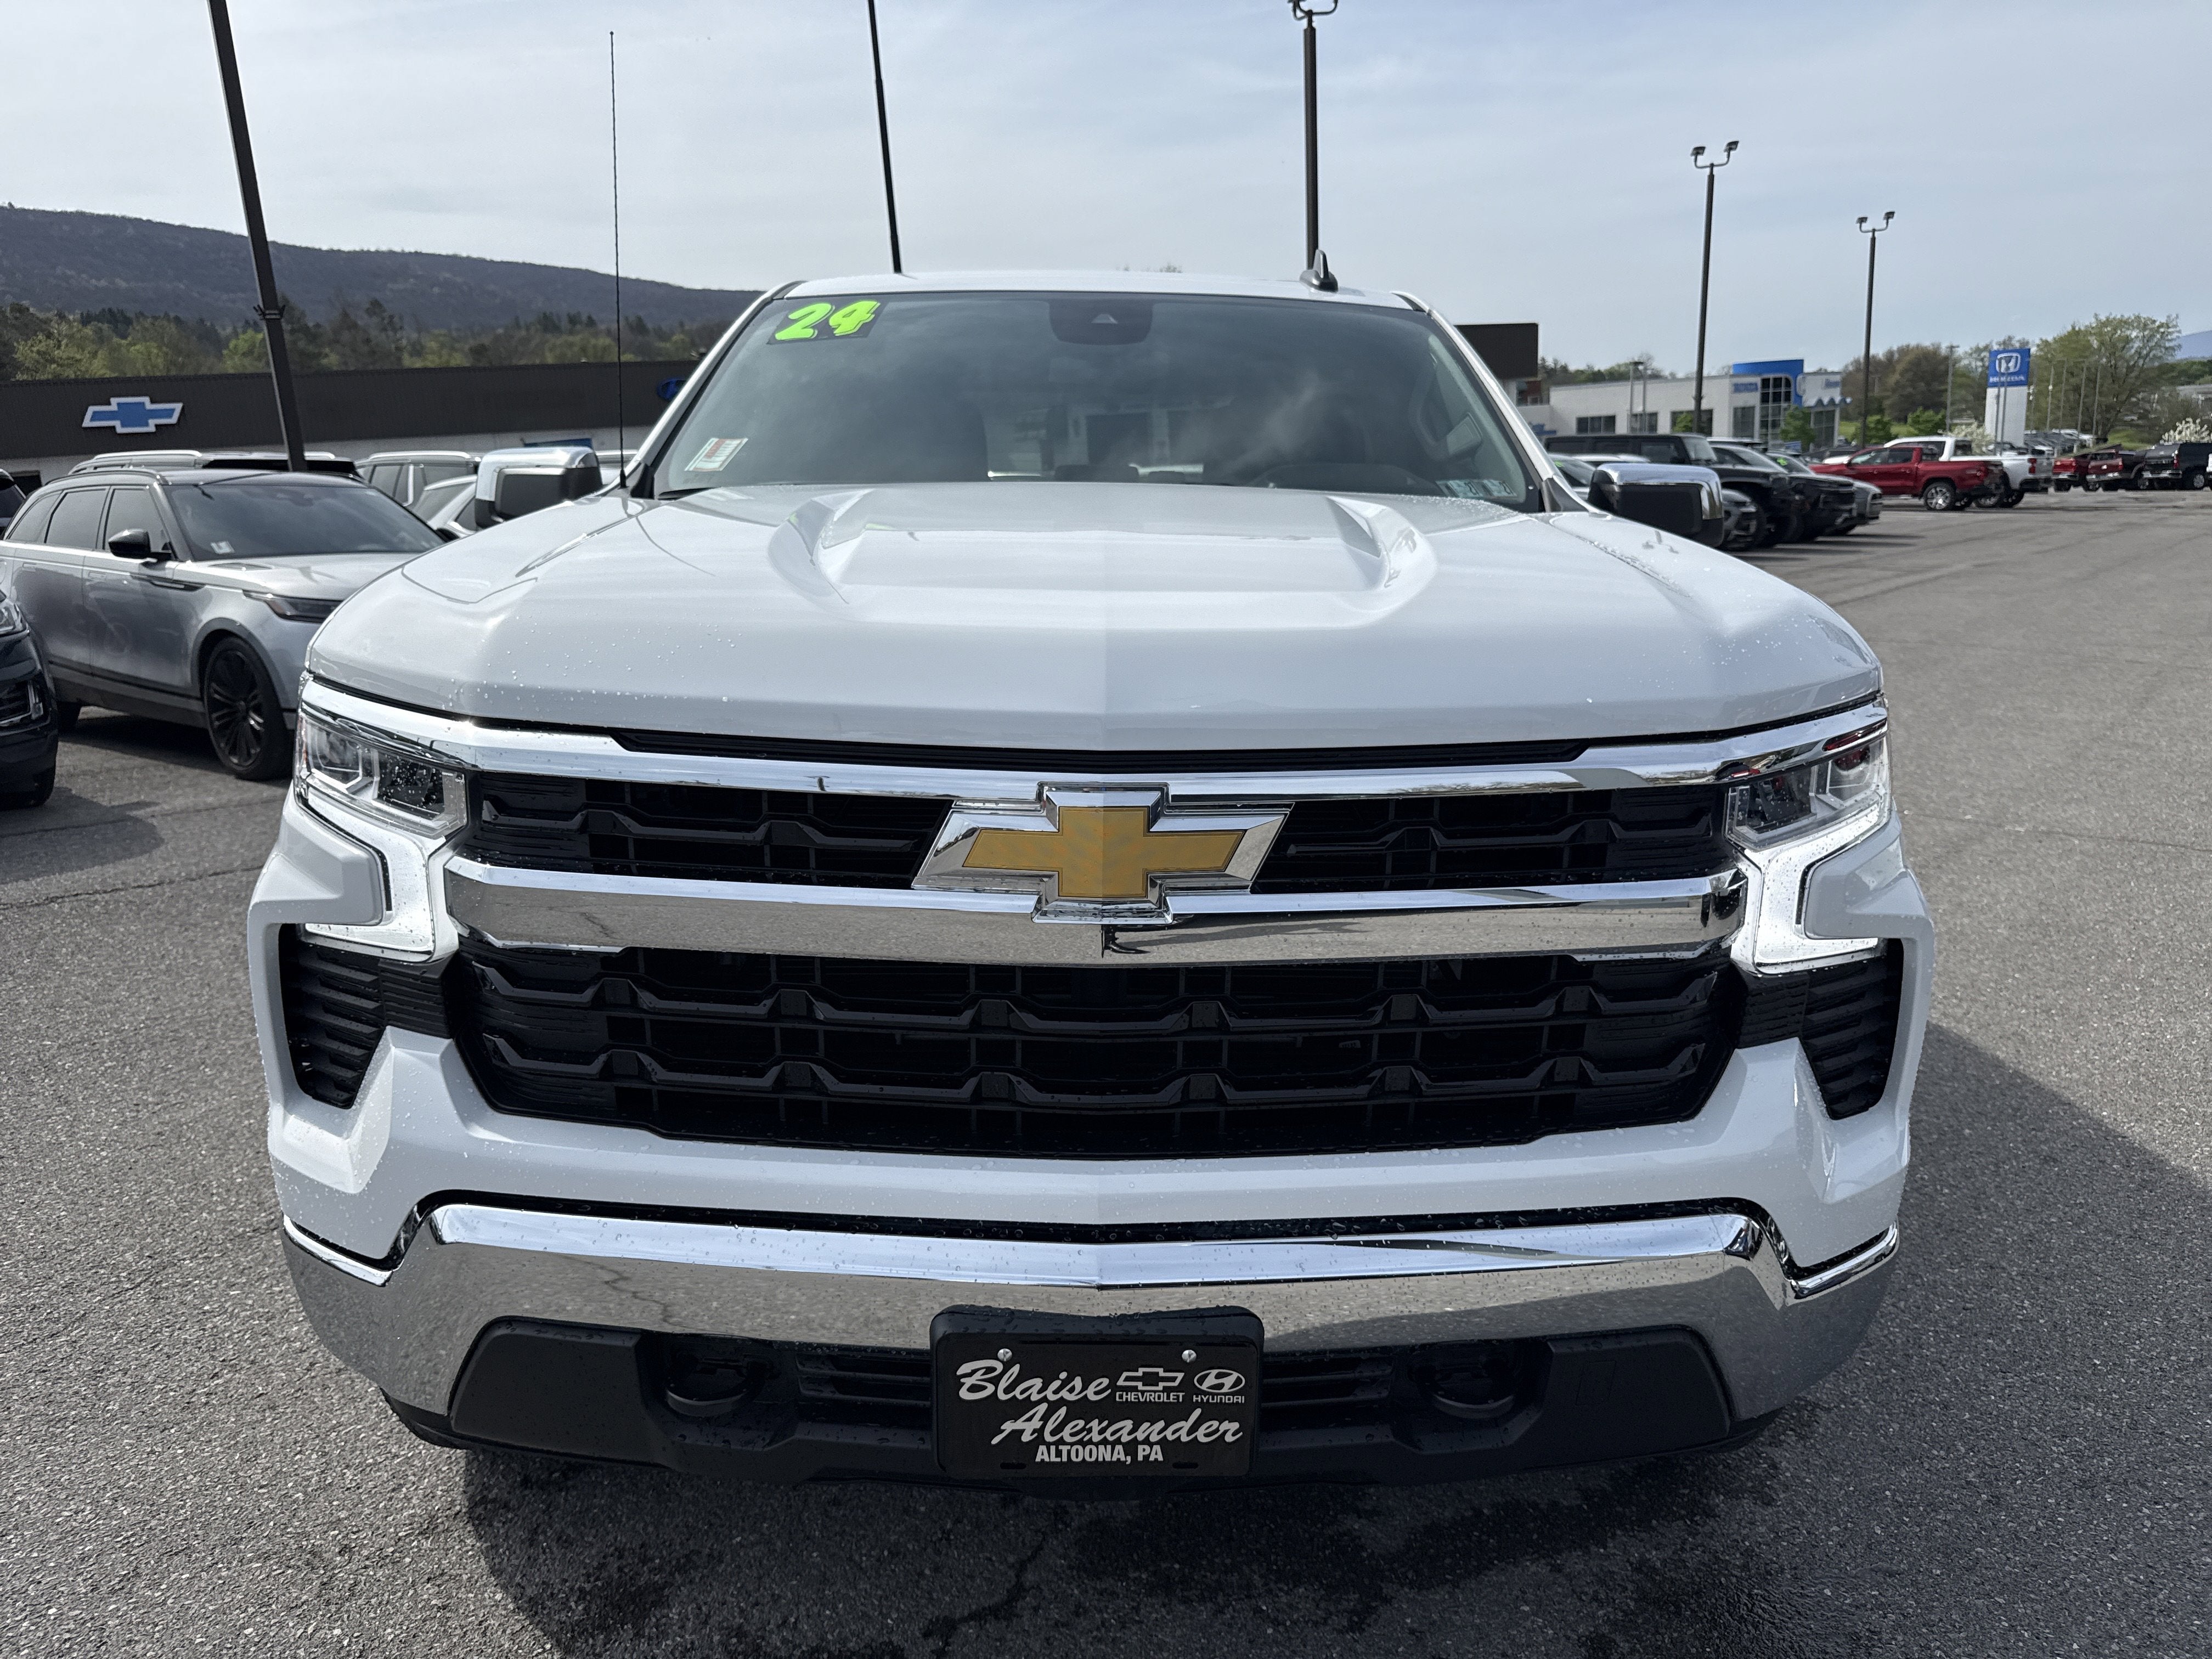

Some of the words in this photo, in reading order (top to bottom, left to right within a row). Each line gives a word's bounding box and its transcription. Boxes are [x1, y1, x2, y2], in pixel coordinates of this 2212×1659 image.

[775, 301, 881, 341] 24
[956, 1358, 1111, 1401] Blaise
[1115, 1391, 1186, 1402] CHEVROLET
[1193, 1395, 1245, 1403] HYUNDAI
[991, 1402, 1243, 1444] Alexander
[1035, 1444, 1131, 1464] ALTOONA,
[1137, 1444, 1164, 1462] PA
